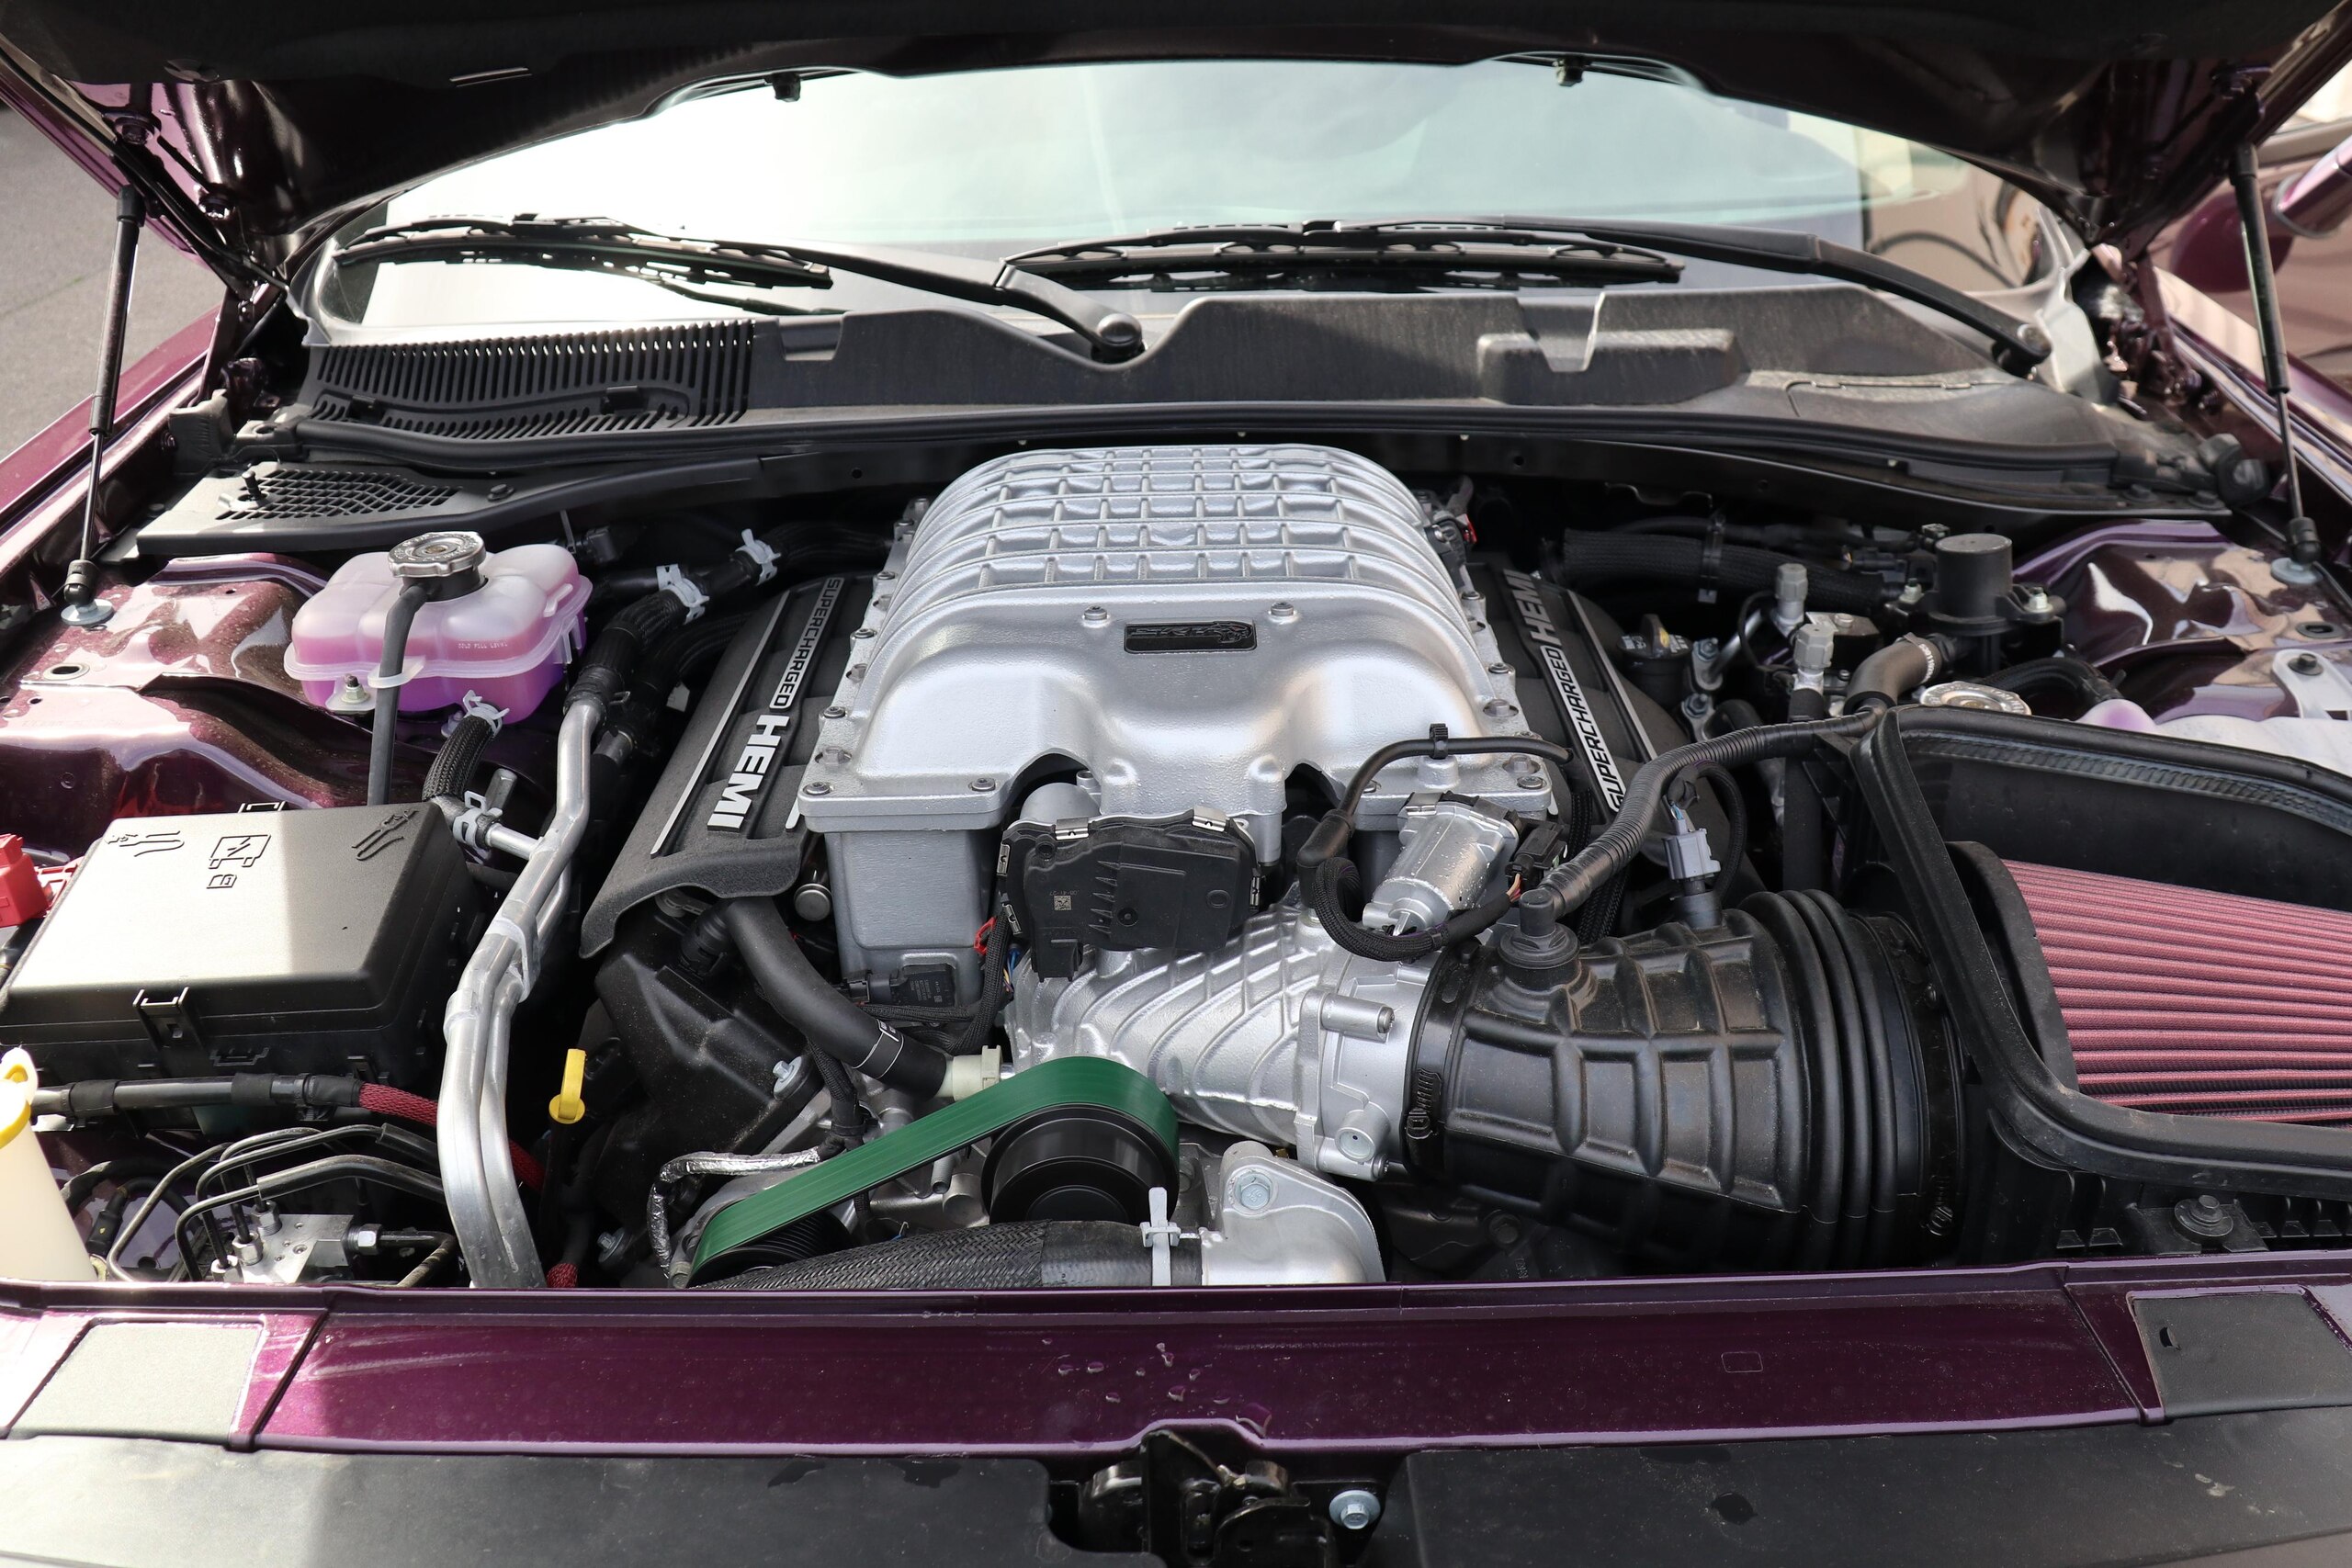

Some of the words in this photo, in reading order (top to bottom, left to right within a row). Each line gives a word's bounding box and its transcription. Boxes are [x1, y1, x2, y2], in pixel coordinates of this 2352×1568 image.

[774, 579, 841, 706] SUPERCHARGED
[1502, 569, 1562, 647] HEMI
[707, 715, 790, 831] HEMI
[1545, 648, 1624, 808] SUPERCHARGED
